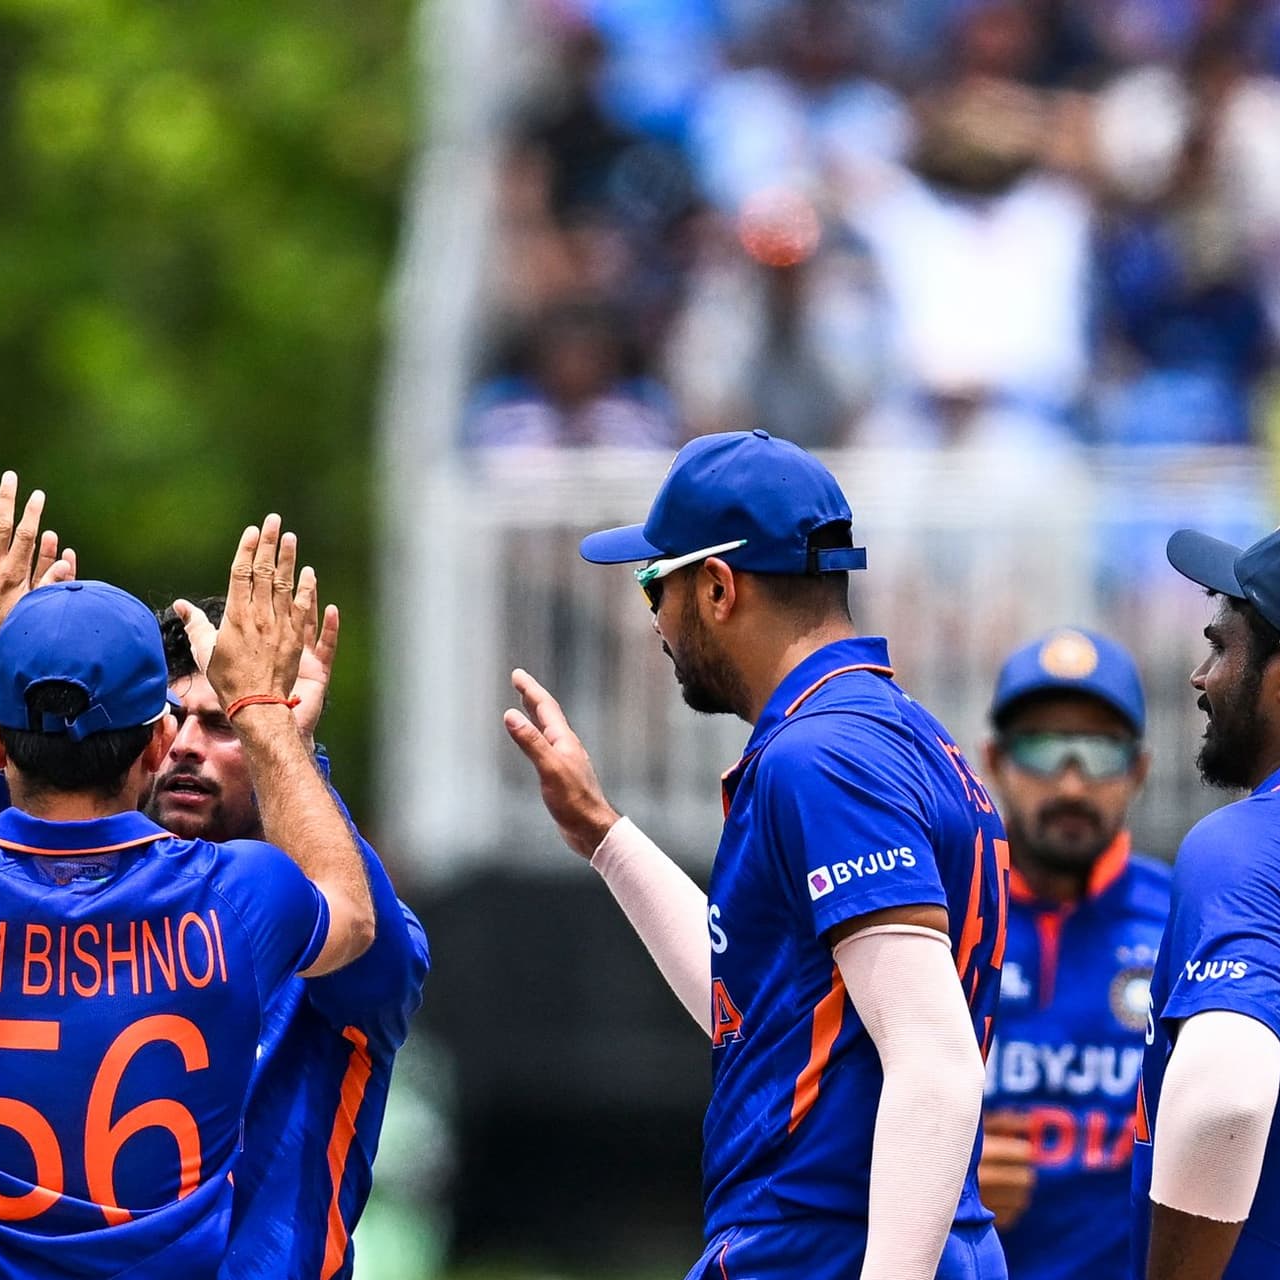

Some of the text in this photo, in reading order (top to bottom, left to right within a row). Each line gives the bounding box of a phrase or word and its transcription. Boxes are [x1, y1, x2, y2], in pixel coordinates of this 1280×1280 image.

[831, 847, 916, 885] BYJU'S
[21, 908, 228, 998] BISHNOI
[1179, 960, 1248, 982] YJU'S
